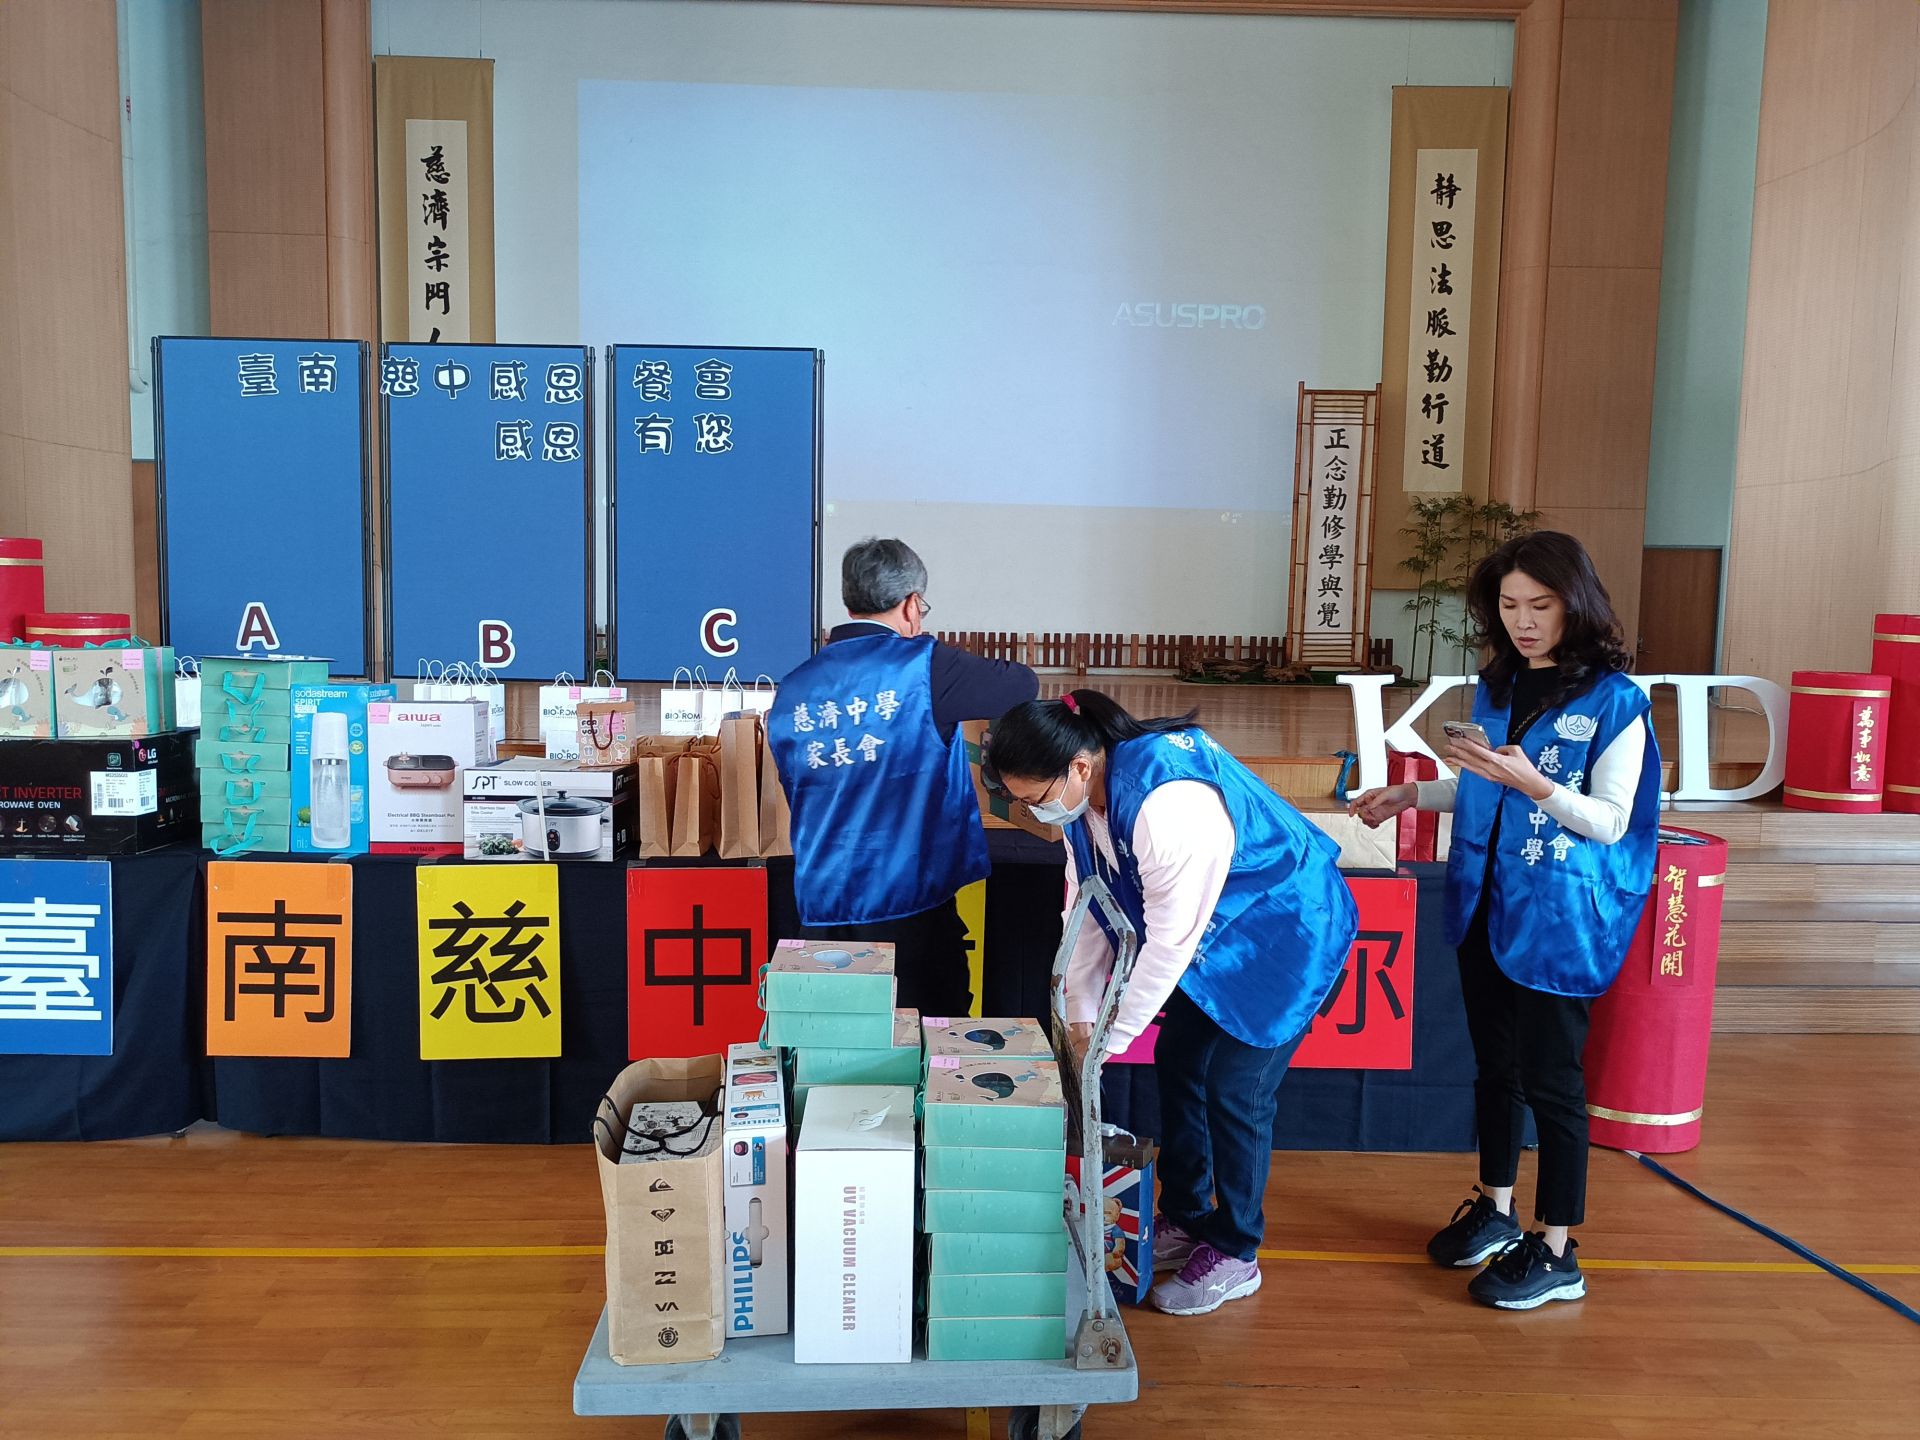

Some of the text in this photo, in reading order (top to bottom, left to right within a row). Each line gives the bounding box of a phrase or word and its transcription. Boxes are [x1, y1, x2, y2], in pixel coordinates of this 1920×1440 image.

[1112, 302, 1266, 330] ASUSPRO
[1316, 427, 1350, 629] 正念勤修學與覺
[237, 602, 280, 650] A
[480, 621, 515, 667] B
[701, 609, 738, 657] C
[294, 688, 348, 698] sodastream
[793, 690, 900, 733] 慈濟中學
[397, 713, 442, 722] aiwa
[147, 748, 157, 759] LG
[806, 733, 886, 770] 家長會
[14, 786, 82, 799] INVERTER
[38, 801, 61, 809] OVEN
[1520, 745, 1563, 866] 慈中學
[1546, 769, 1586, 862] 家會
[1660, 864, 1688, 977] 智慧花開
[0, 897, 102, 1022] 臺
[217, 900, 343, 1023] 南
[428, 901, 553, 1022] 慈
[644, 904, 751, 1026] 中
[842, 1185, 857, 1331] UV VACUUM CLEANER
